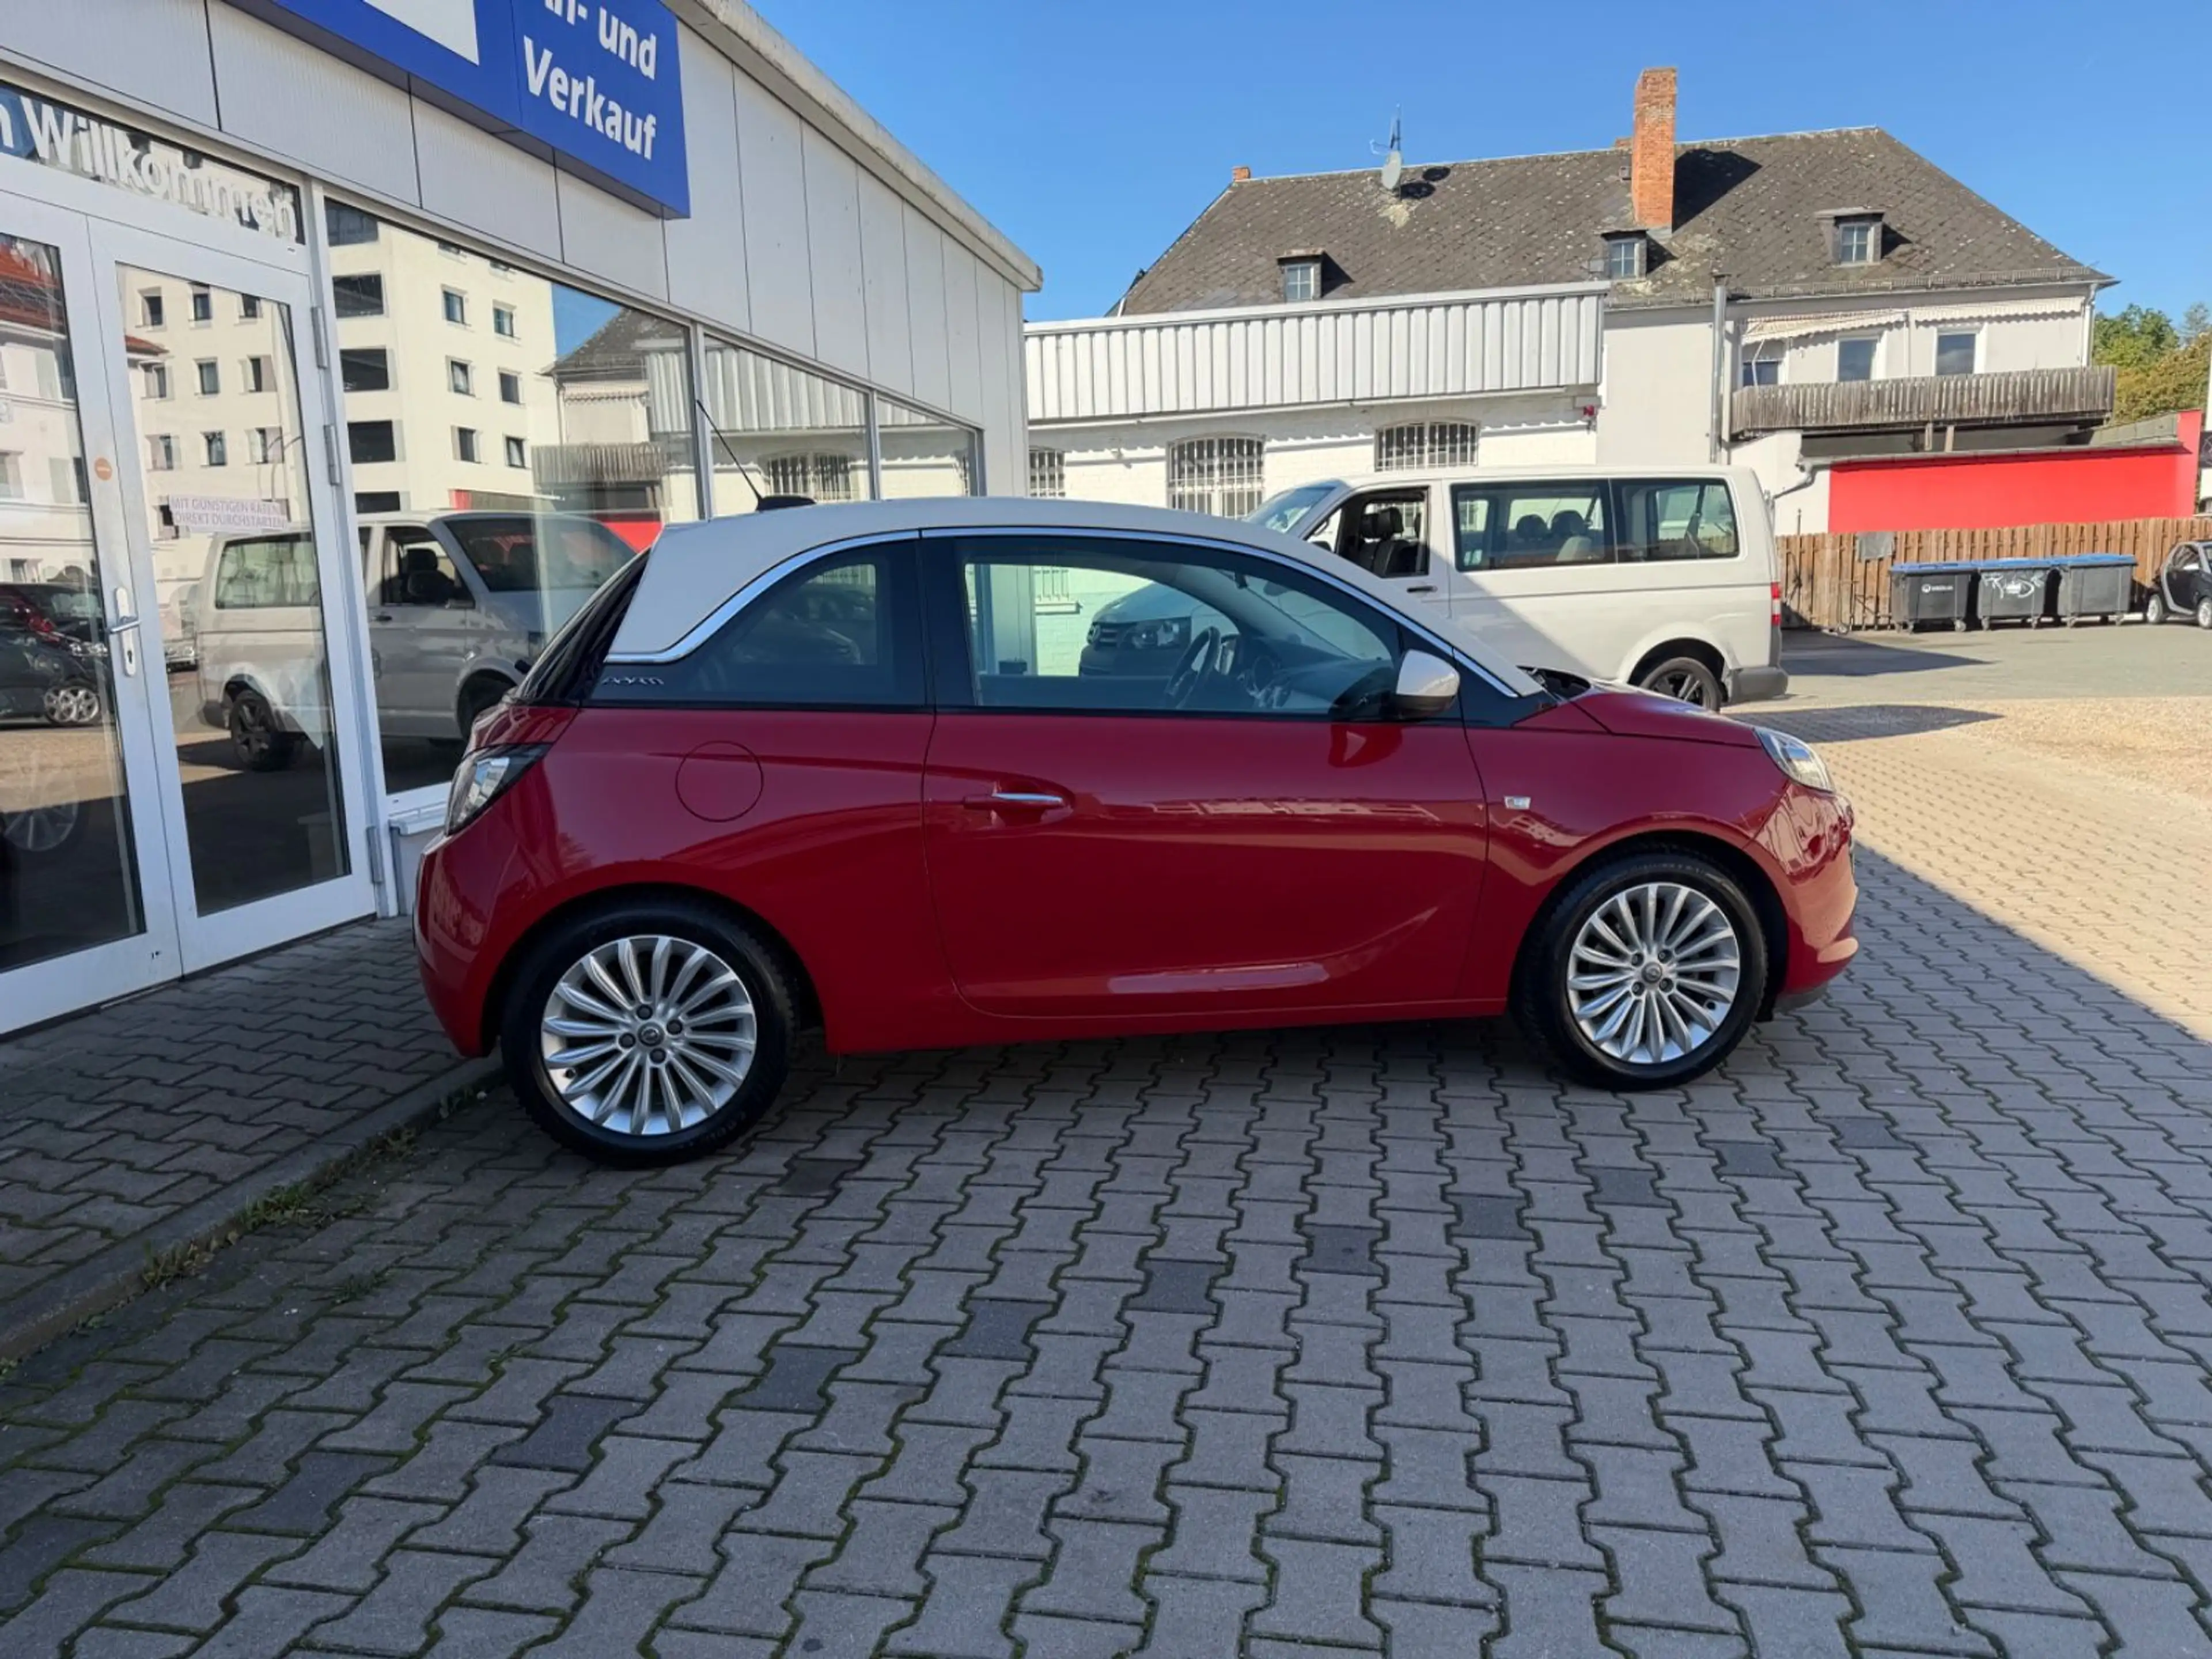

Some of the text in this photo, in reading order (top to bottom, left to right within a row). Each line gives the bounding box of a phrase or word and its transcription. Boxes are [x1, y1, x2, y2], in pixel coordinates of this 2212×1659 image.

[524, 35, 657, 161] Verkauf
[599, 6, 657, 81] und
[20, 94, 298, 238] Willkommen
